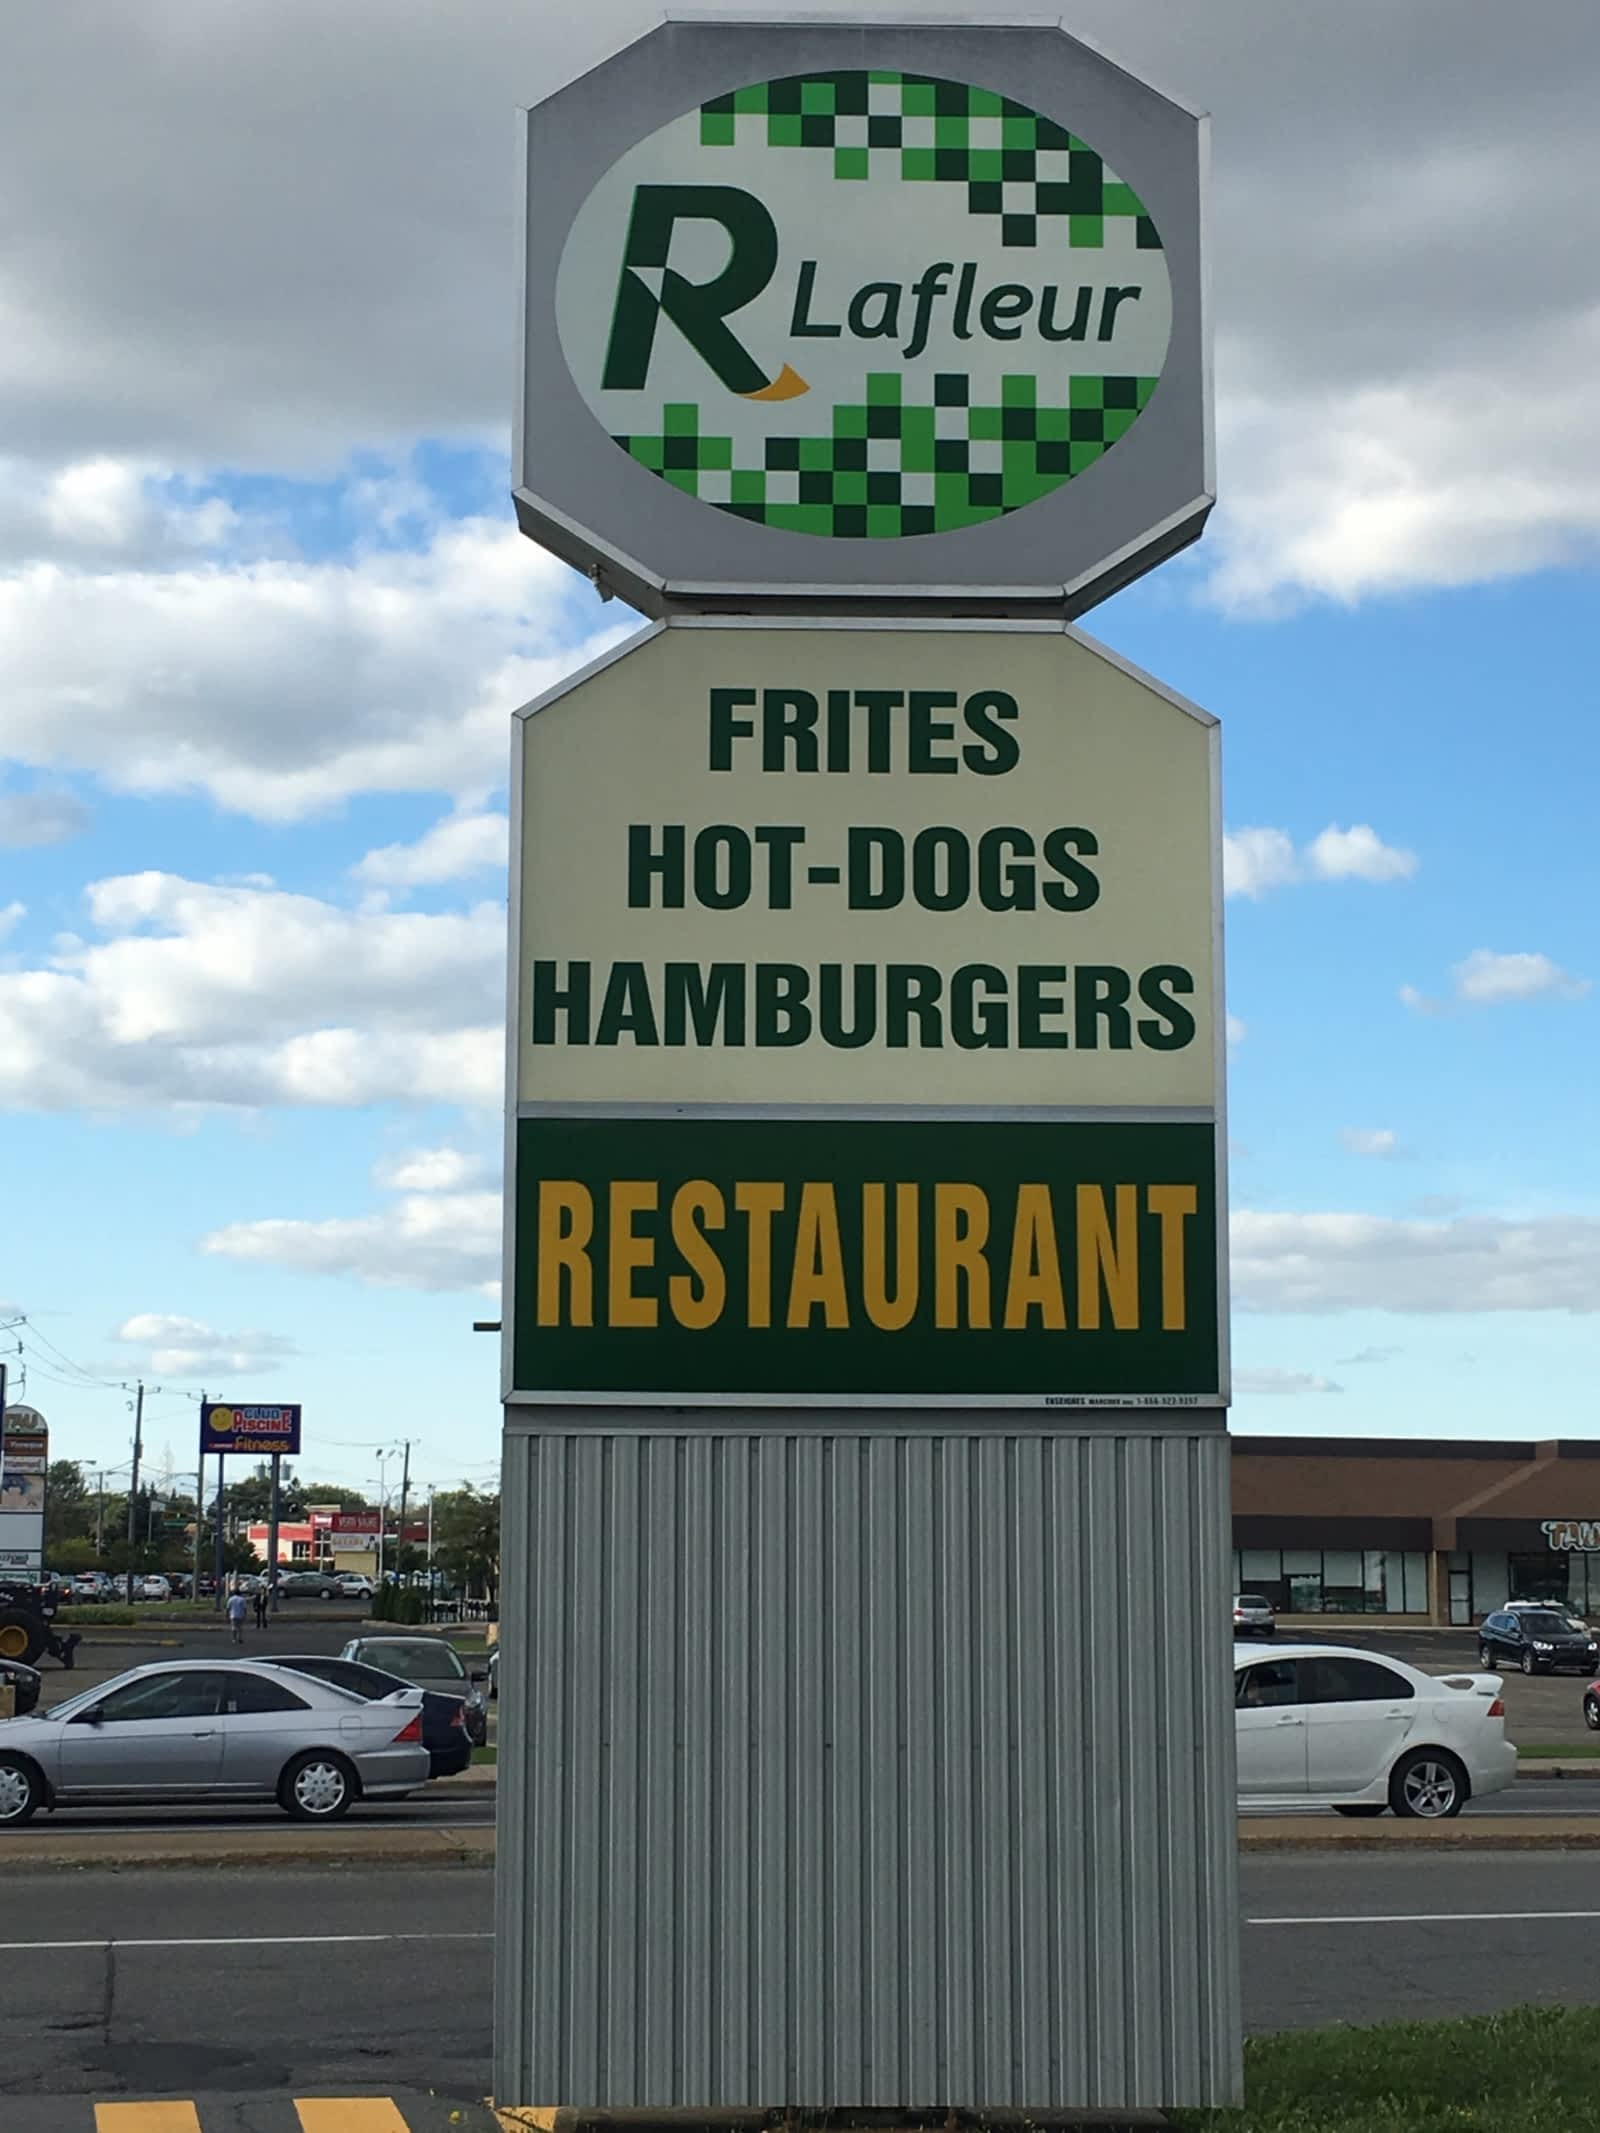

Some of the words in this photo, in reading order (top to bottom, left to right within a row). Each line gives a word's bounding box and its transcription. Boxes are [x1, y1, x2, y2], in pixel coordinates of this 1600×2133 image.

[789, 260, 1142, 359] Lafleur
[709, 688, 1020, 776] FRITES
[627, 825, 1101, 912] HOT-DOGS
[532, 960, 1197, 1051] HAMBURGERS
[536, 1179, 1198, 1331] RESTAURANT
[232, 1409, 292, 1433] PISCINE
